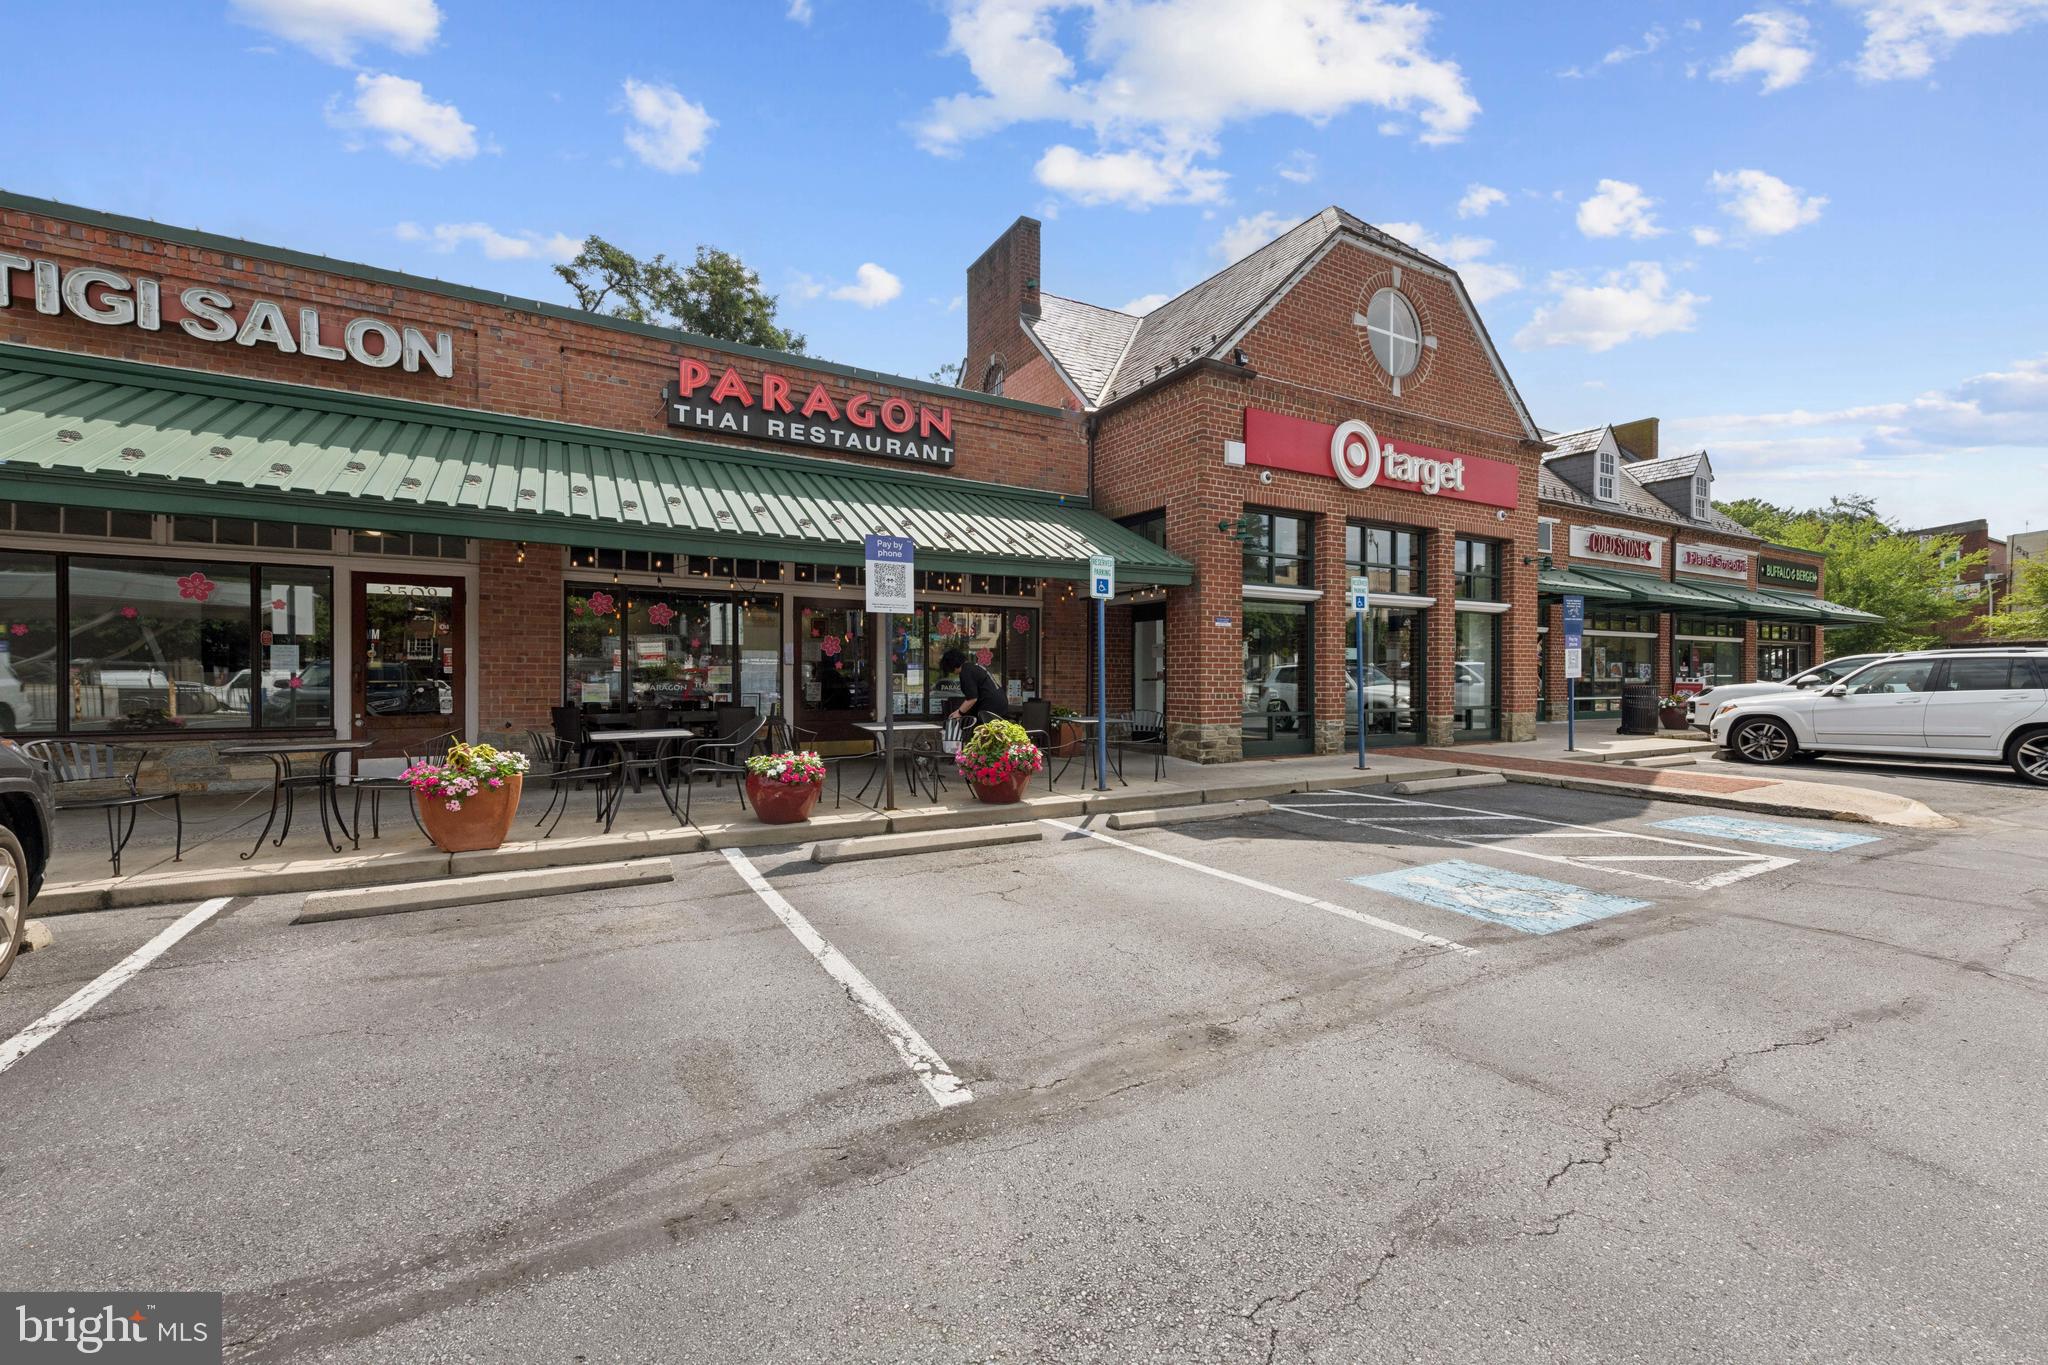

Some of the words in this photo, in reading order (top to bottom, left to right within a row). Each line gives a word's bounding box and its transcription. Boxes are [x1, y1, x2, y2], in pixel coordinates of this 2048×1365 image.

[179, 287, 454, 379] SALON
[679, 357, 951, 441] PARAGON
[673, 404, 749, 432] THAI
[767, 419, 954, 463] RESTAURANT
[1382, 443, 1465, 495] target
[877, 539, 892, 550] Pay
[893, 541, 903, 550] by
[878, 549, 903, 558] phone
[1591, 532, 1616, 554] COLD
[1617, 537, 1646, 559] STONE
[1094, 568, 1112, 577] PARKING
[1766, 564, 1791, 580] BUFFALO
[644, 683, 688, 692] ARAGON
